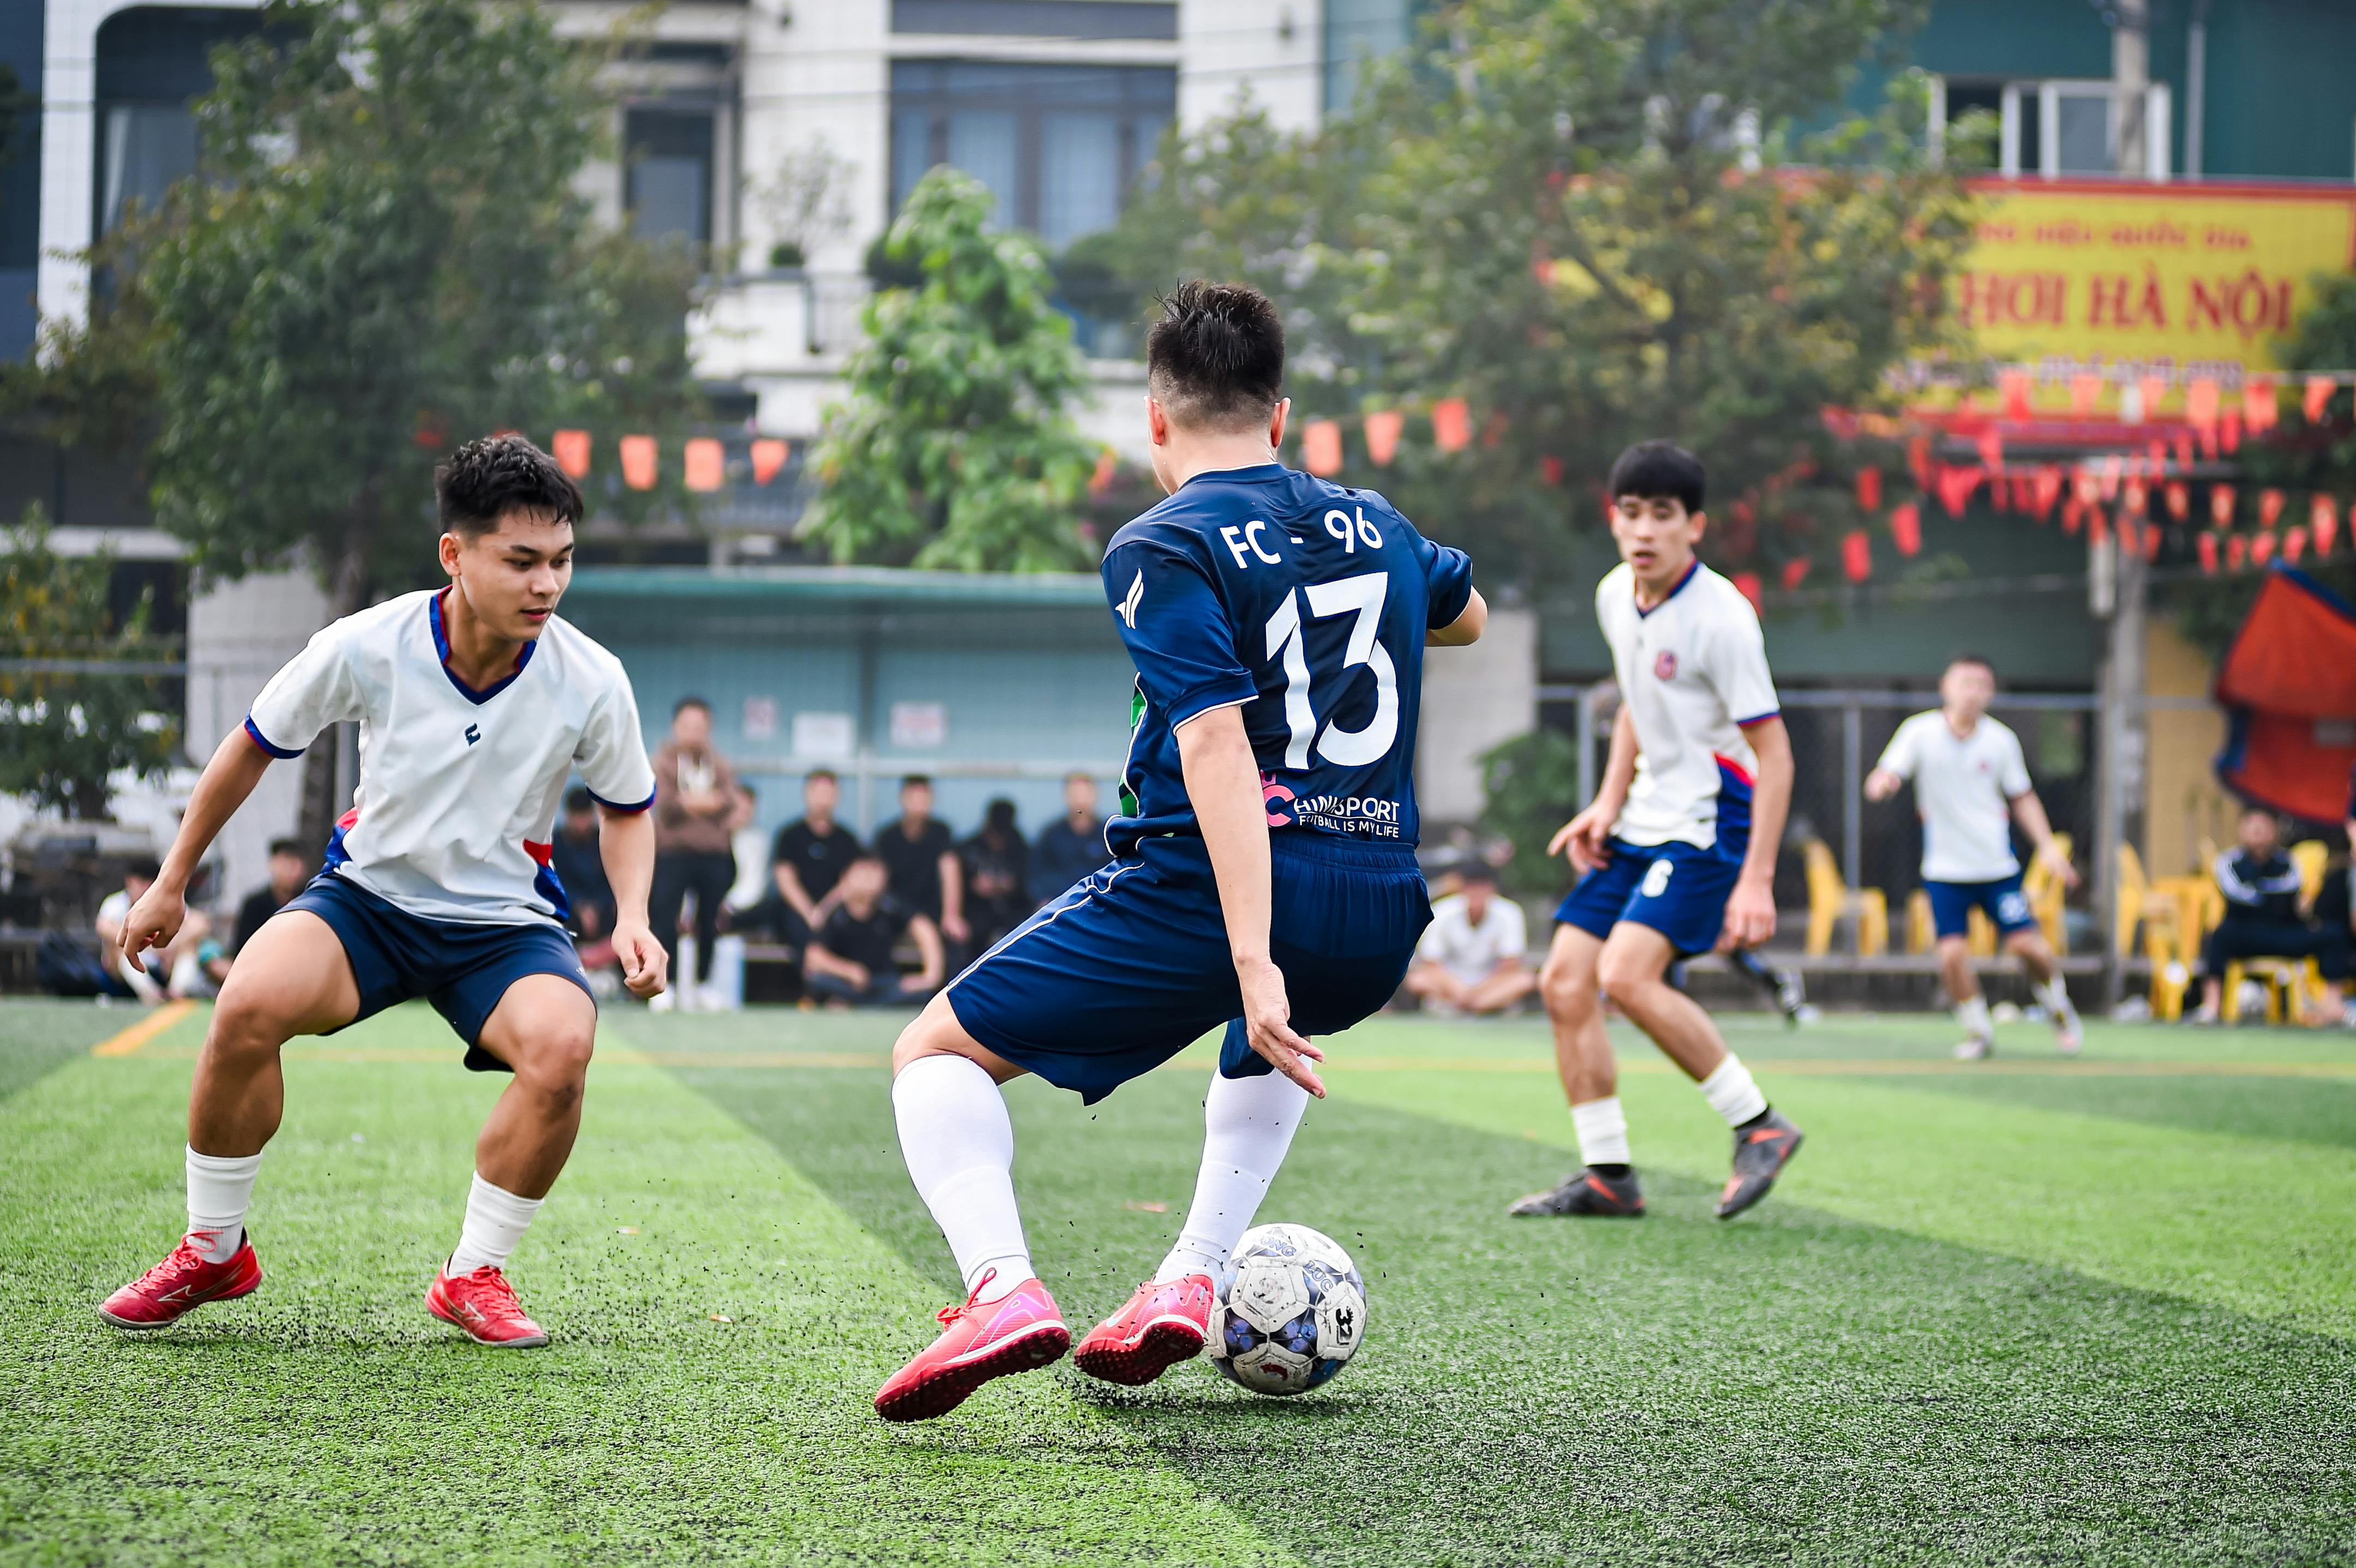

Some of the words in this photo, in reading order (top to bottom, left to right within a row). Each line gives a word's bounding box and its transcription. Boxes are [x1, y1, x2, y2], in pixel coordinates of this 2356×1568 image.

[2088, 260, 2168, 329] HÀ
[2186, 265, 2293, 347] NỘI
[1220, 520, 1282, 569] FC
[1324, 506, 1383, 554] 96
[1266, 572, 1399, 770] 13
[1343, 820, 1355, 832] IS
[1641, 858, 1674, 898] 6
